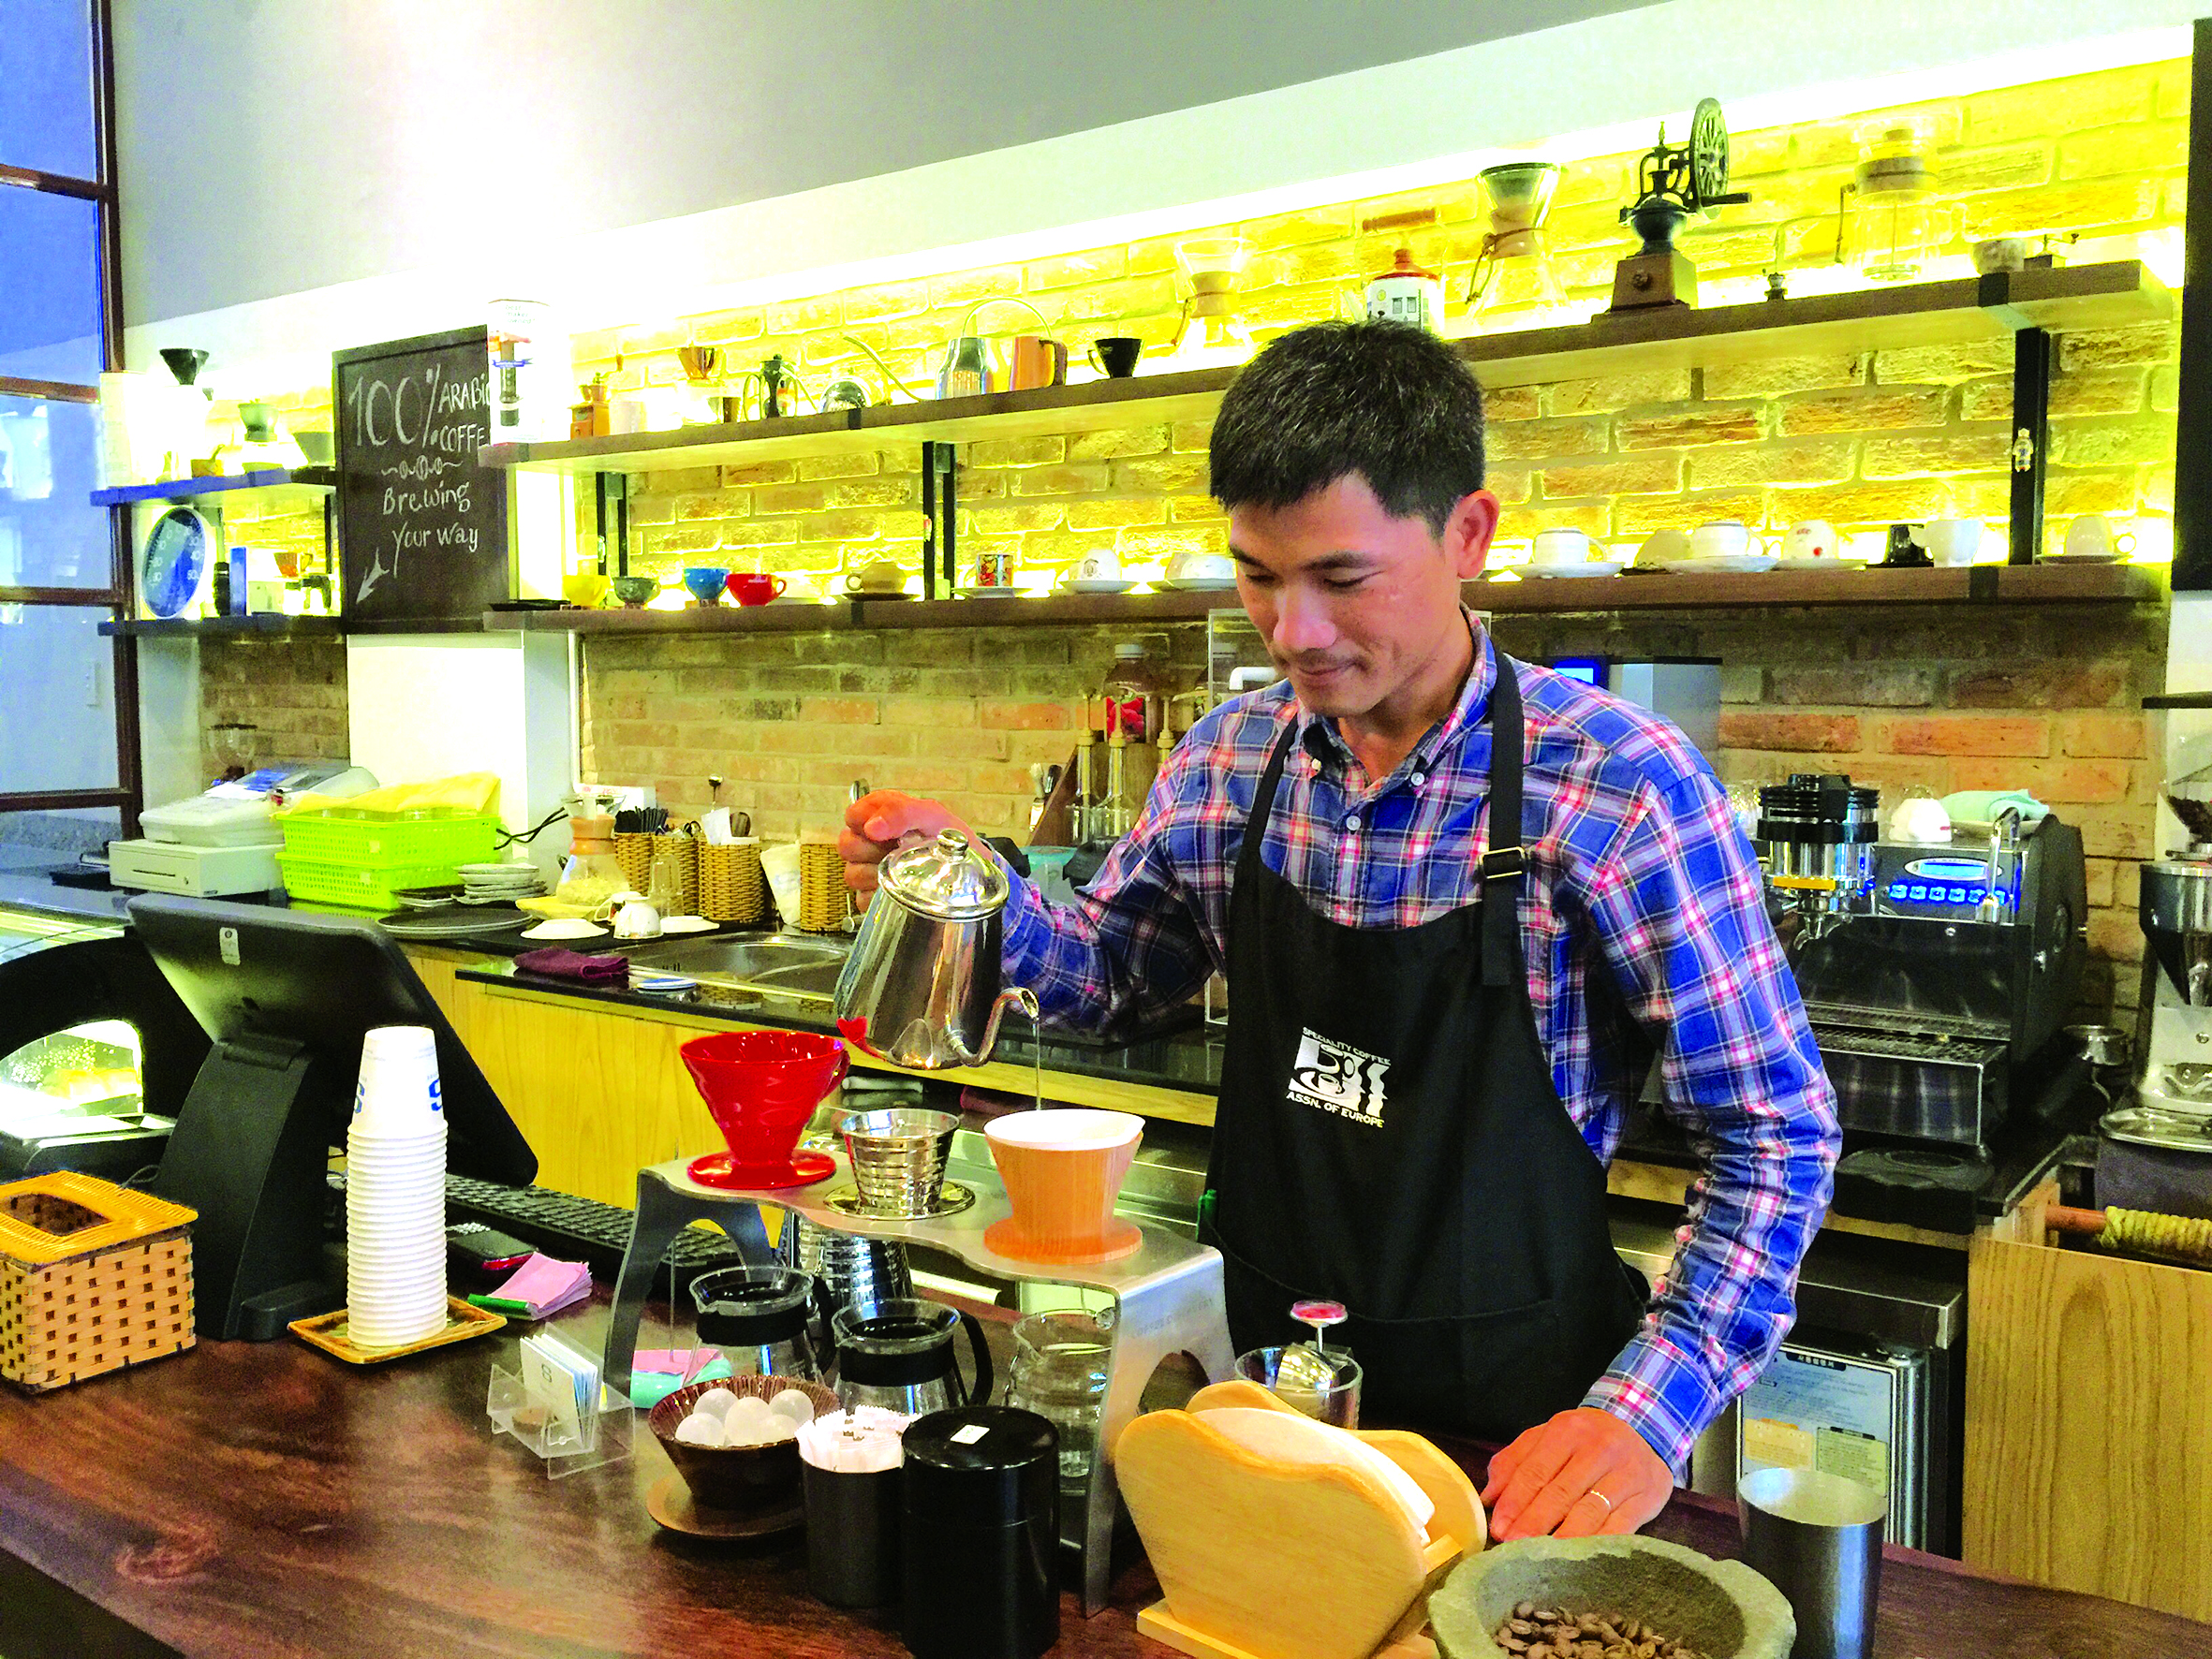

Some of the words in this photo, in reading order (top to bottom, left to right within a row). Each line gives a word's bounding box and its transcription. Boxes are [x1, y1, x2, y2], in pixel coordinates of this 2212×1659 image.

[383, 479, 471, 515] Brewing
[1286, 1091, 1322, 1109] ASSN.
[1323, 1102, 1340, 1114] OF
[1340, 1107, 1385, 1129] EUROPE
